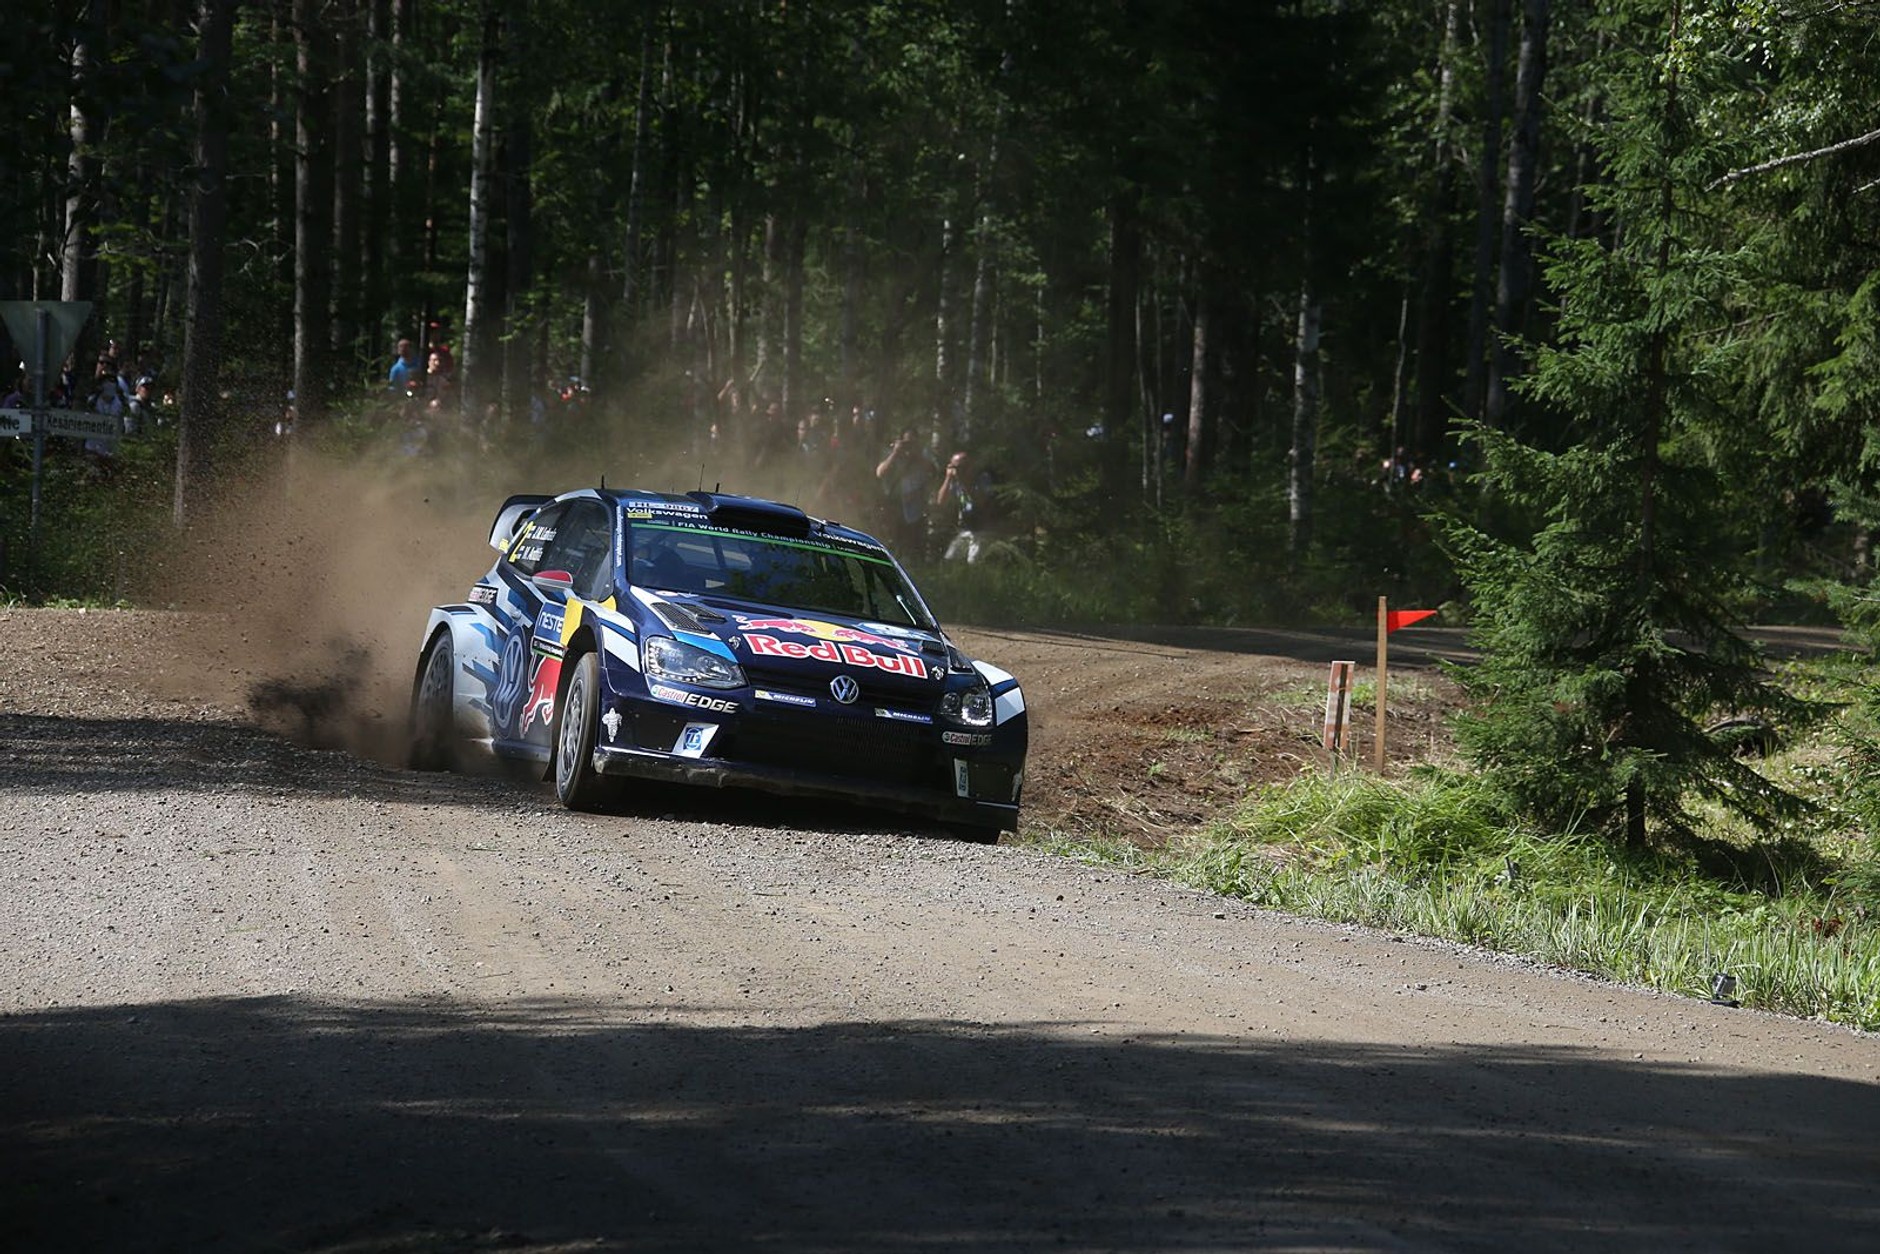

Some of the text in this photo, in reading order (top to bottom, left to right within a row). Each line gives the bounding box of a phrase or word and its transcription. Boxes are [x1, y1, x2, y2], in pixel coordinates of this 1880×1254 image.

[626, 507, 708, 520] Volkswagen
[678, 521, 696, 529] FIA
[698, 524, 729, 533] World
[732, 528, 757, 537] Rally
[761, 532, 831, 549] Championship
[813, 530, 886, 552] Volkswagen
[540, 612, 563, 634] NESTE
[743, 633, 929, 679] Red Bull
[659, 688, 740, 714] Castrol EDGE
[773, 693, 815, 704] MICHELIN
[892, 712, 931, 722] MICHELIN
[950, 733, 992, 745] Castrol EDGE
